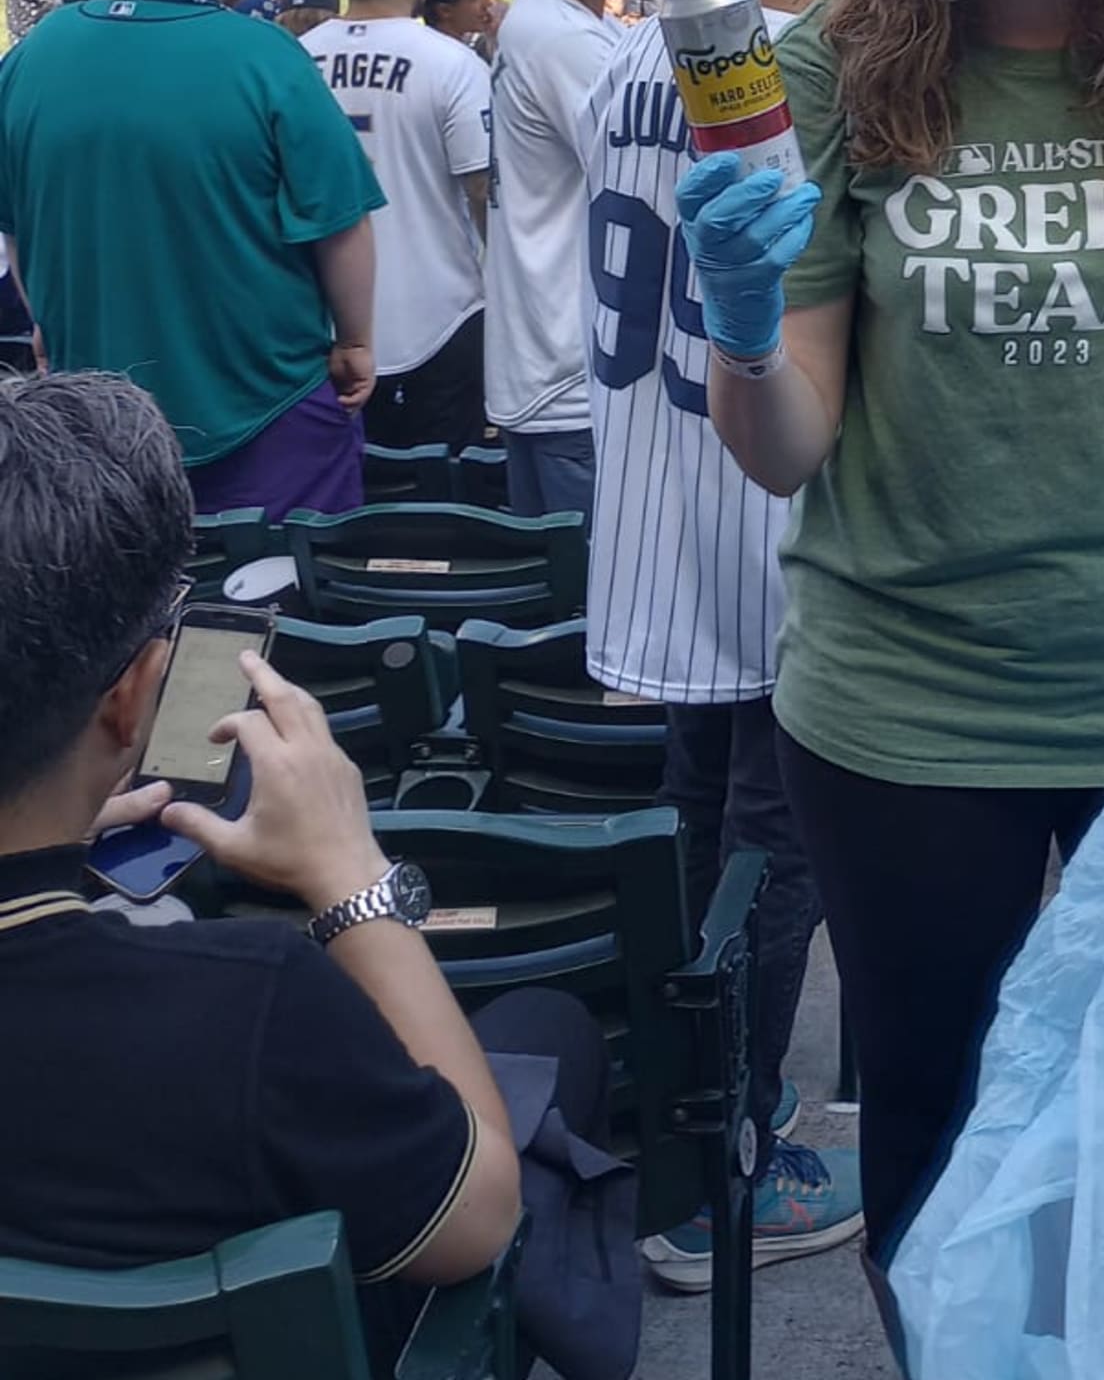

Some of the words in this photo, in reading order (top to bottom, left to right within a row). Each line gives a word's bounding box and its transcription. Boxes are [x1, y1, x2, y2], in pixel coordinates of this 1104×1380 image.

[676, 43, 747, 85] Topo
[709, 88, 745, 107] HARD
[1004, 338, 1090, 365] 2023
